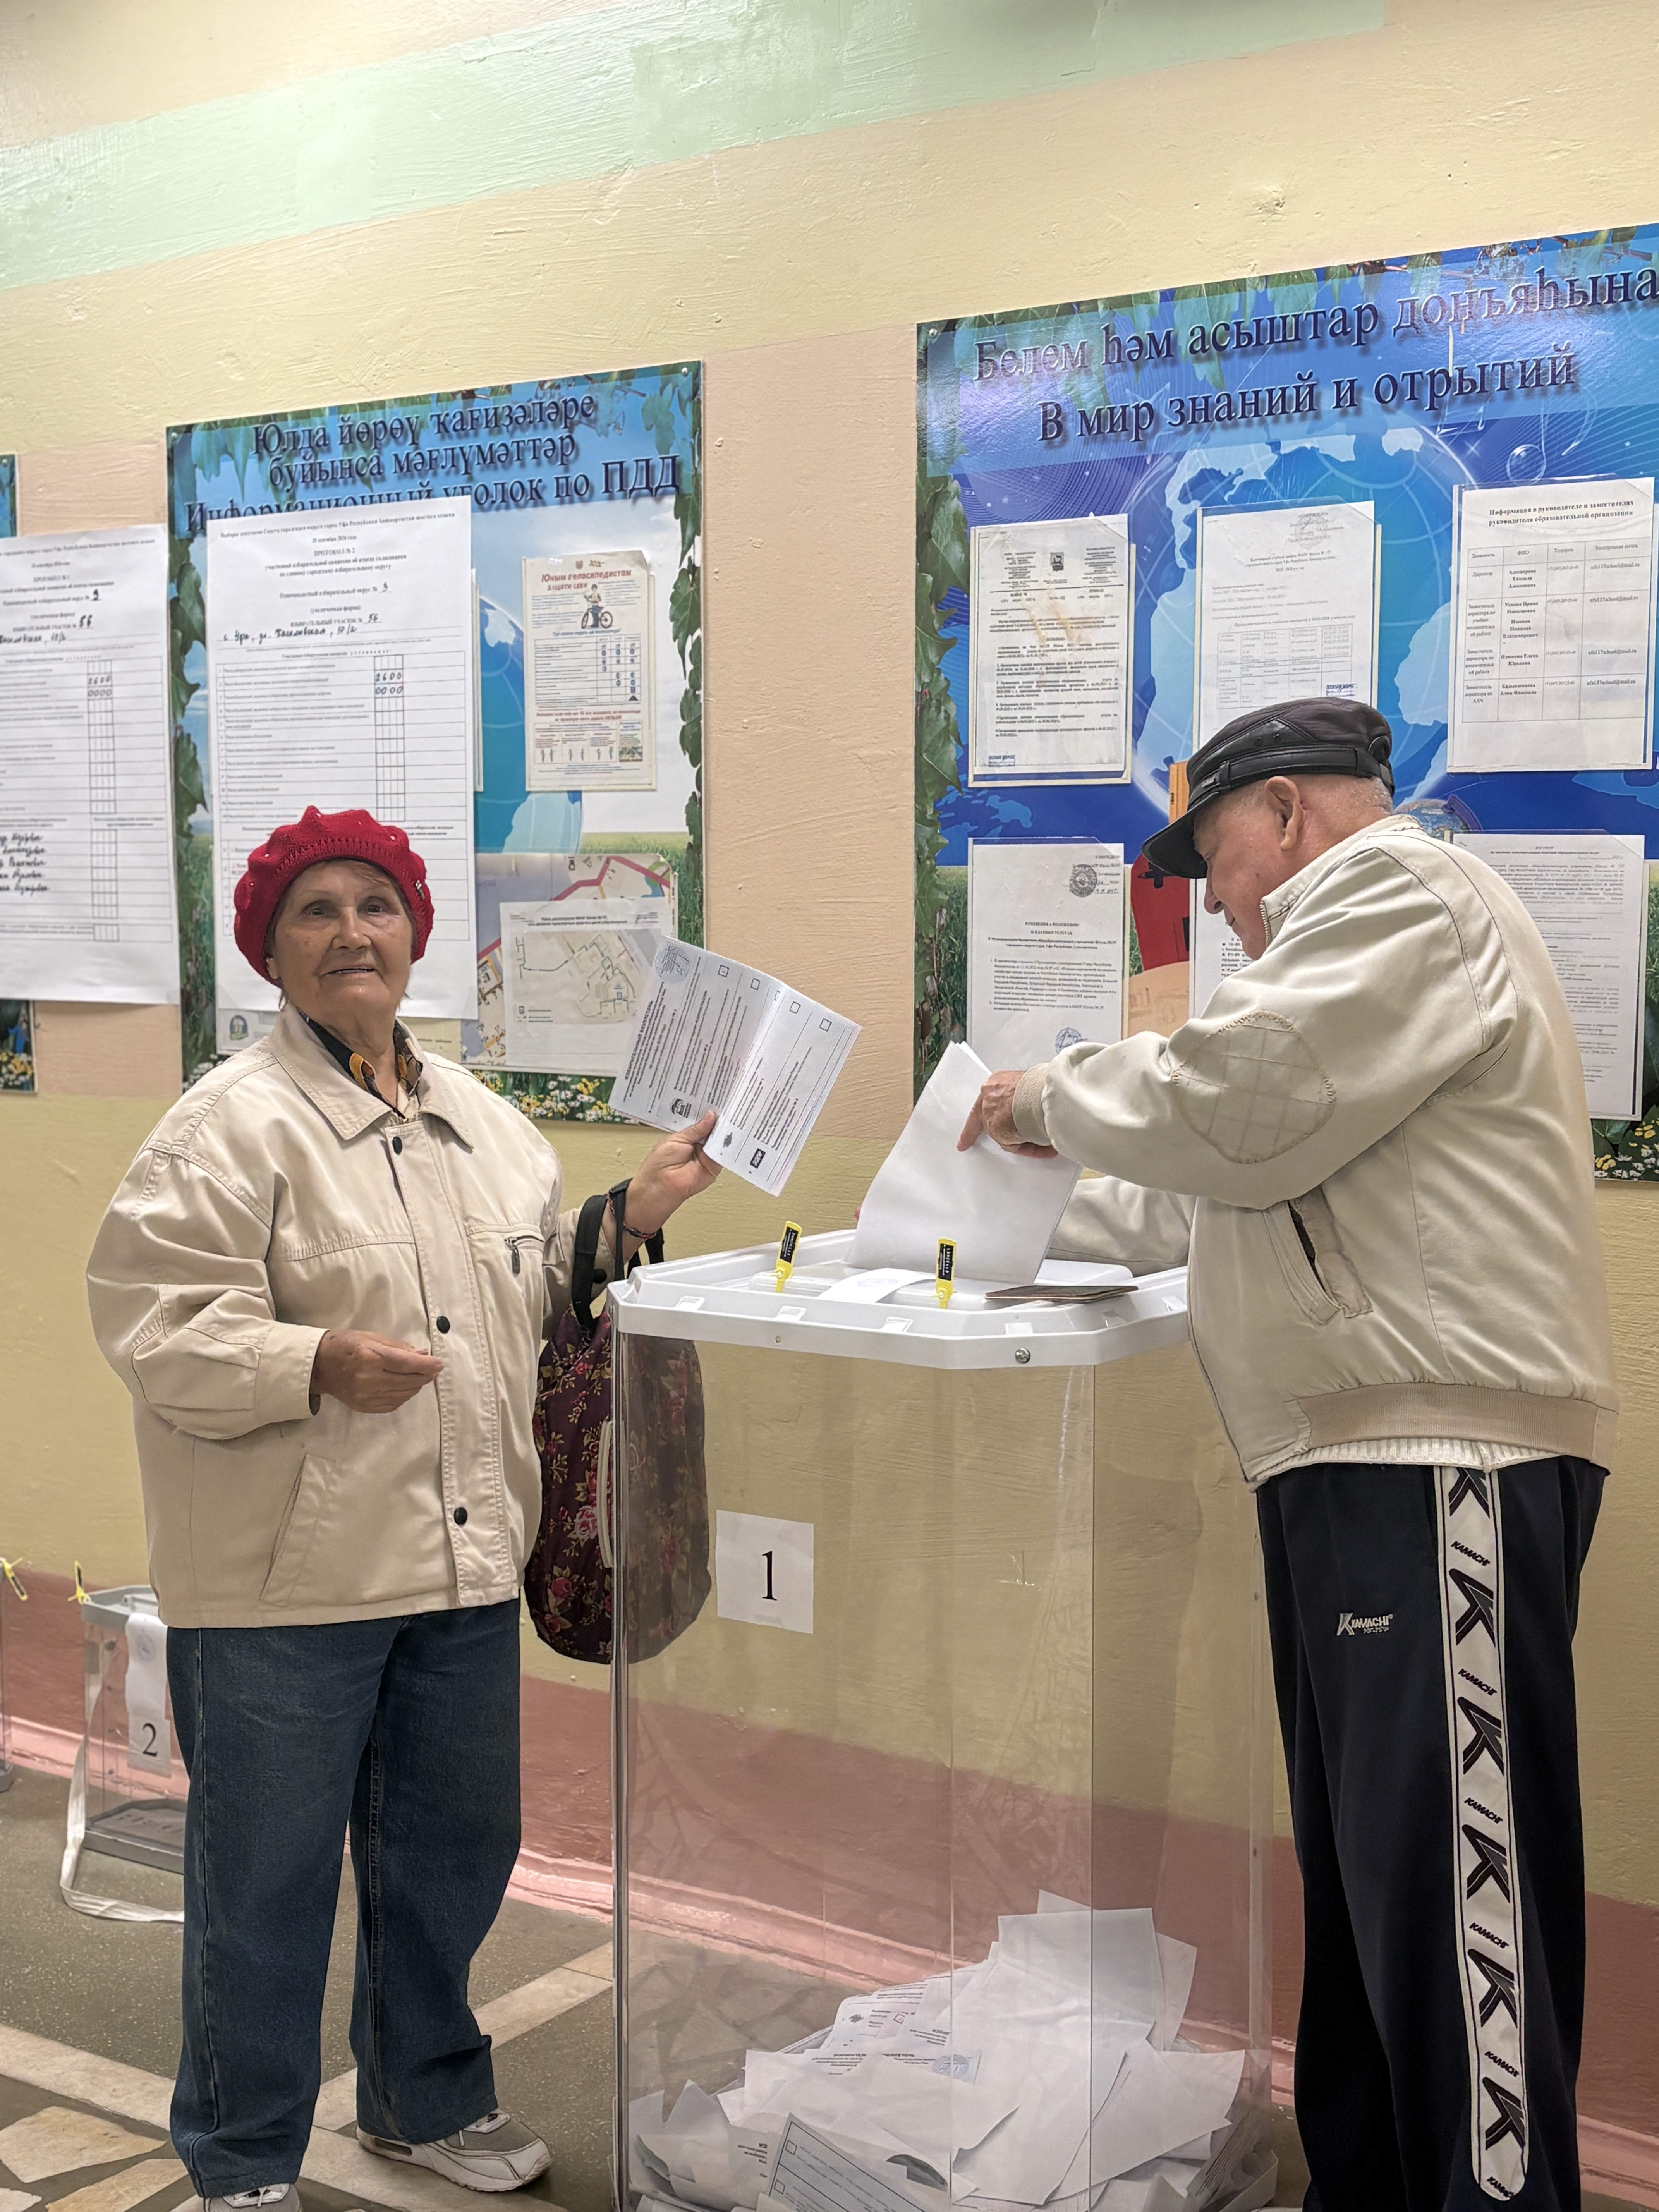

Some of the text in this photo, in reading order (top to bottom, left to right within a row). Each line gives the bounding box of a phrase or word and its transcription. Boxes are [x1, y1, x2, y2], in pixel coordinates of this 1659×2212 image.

[974, 340, 1088, 381] Белем
[1101, 323, 1174, 366] һәм
[1188, 302, 1379, 354] асыштар
[1038, 341, 1575, 443] В мир знаний и отрытий
[252, 422, 329, 455] Юлда
[268, 451, 383, 492] буйынса
[553, 473, 590, 499] по
[601, 455, 680, 500] ПДД
[541, 574, 566, 582] Юным
[762, 1550, 778, 1601] 1
[142, 1723, 158, 1757] 2
